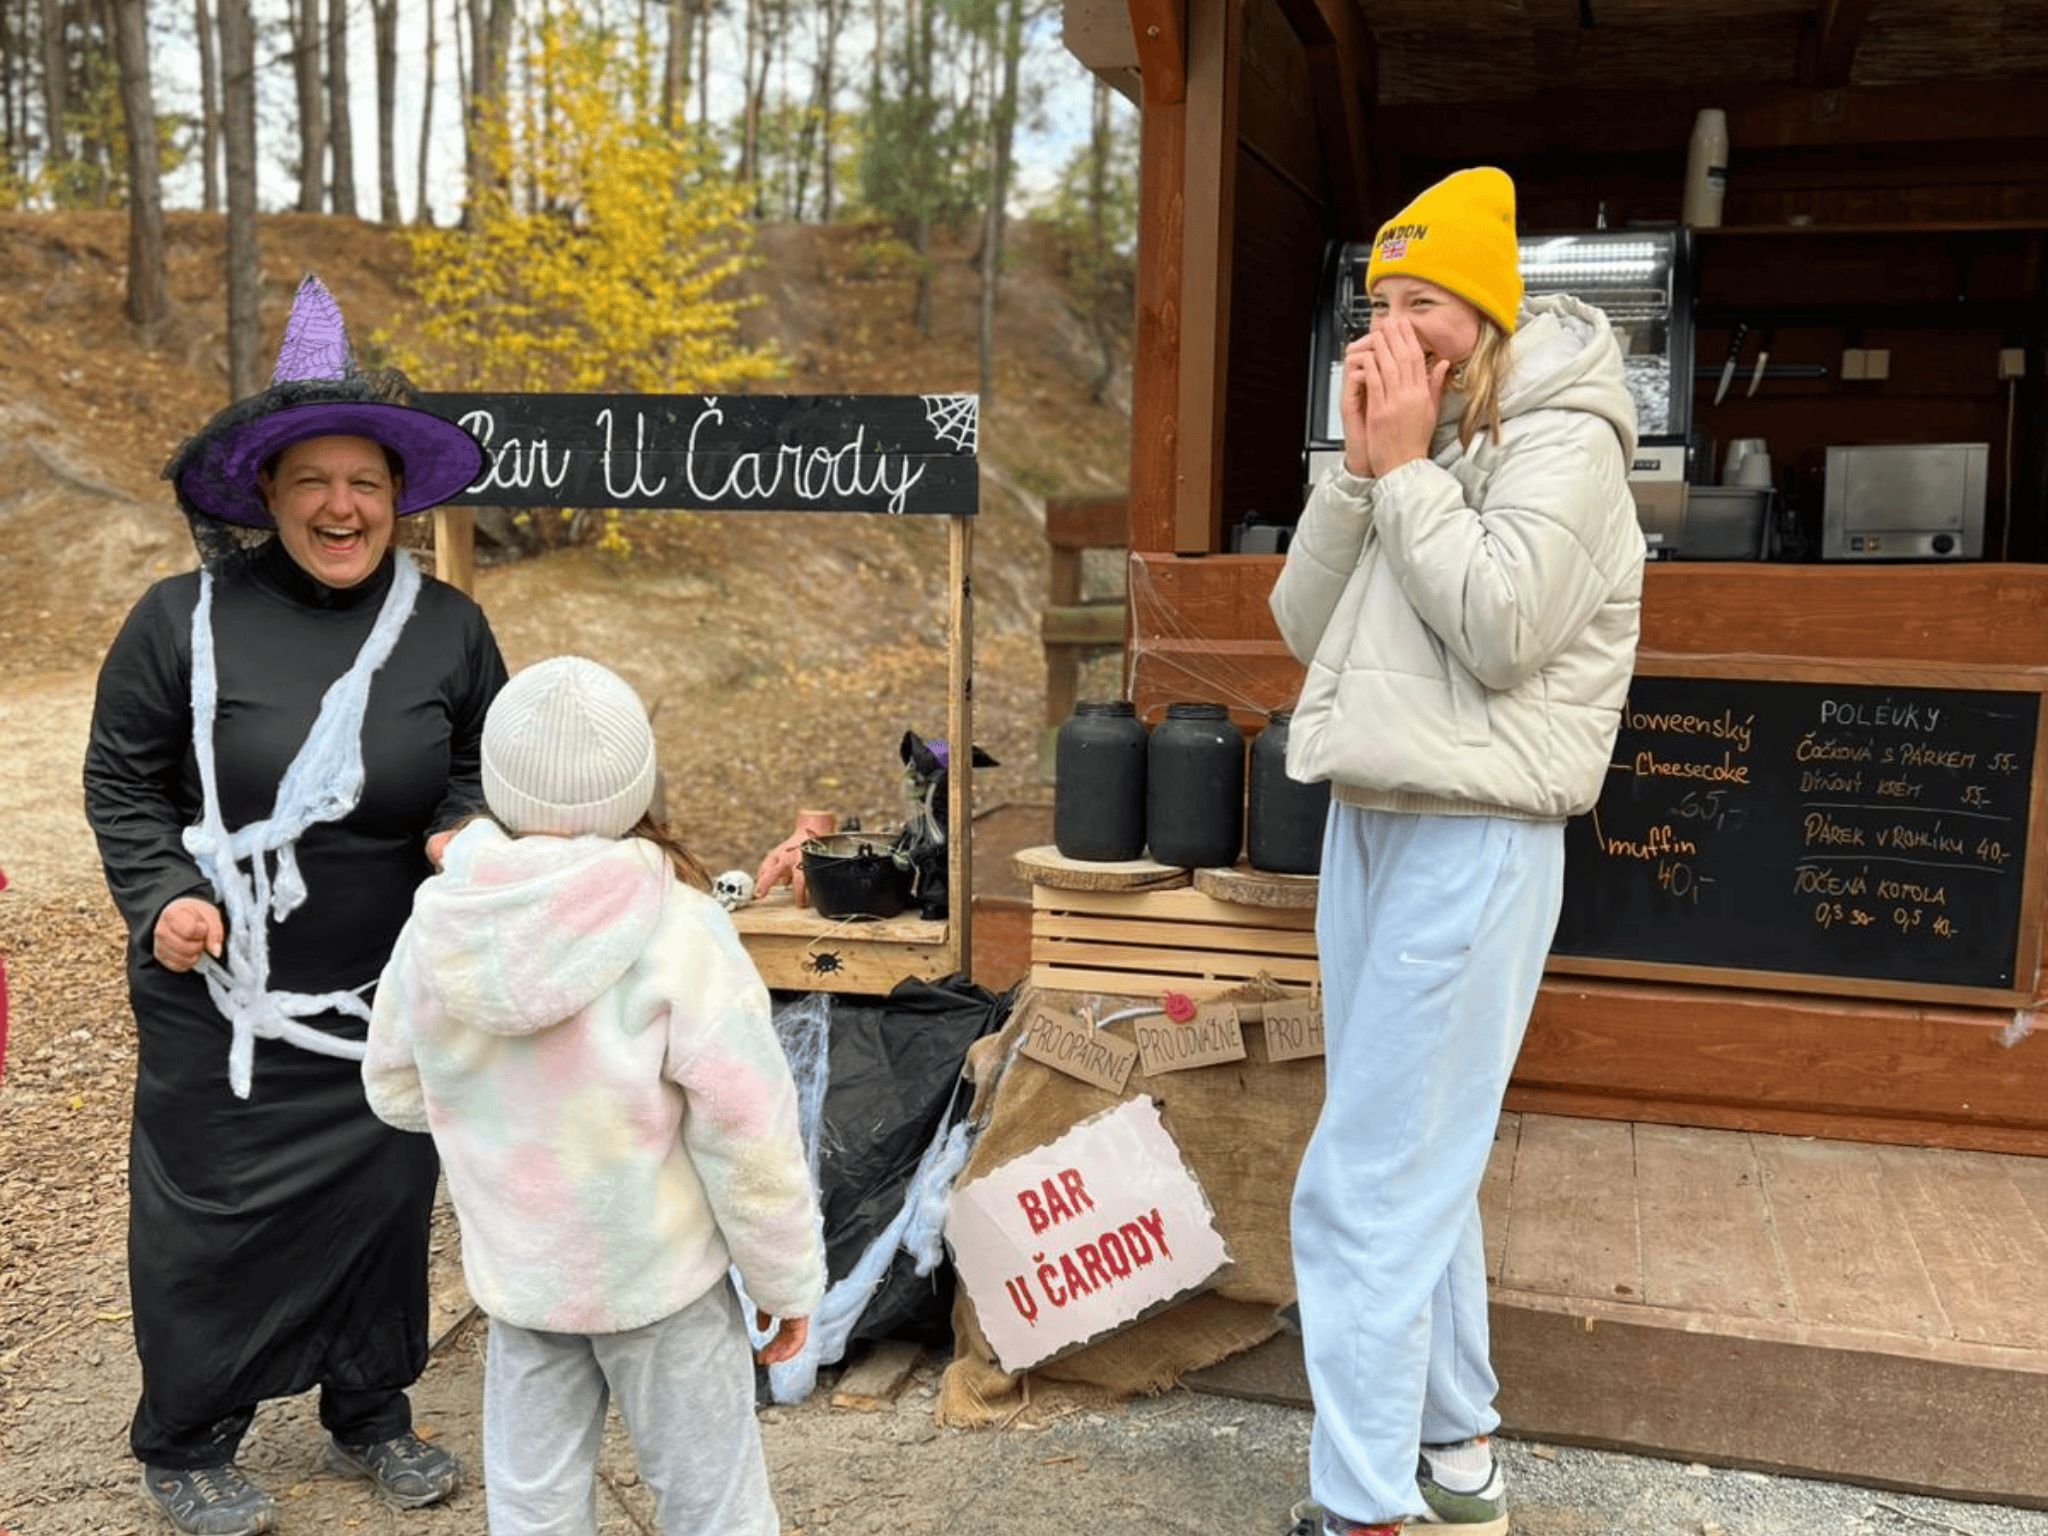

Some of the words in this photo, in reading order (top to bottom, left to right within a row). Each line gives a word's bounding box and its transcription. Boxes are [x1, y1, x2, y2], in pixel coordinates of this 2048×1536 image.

[596, 408, 667, 498] U
[686, 396, 926, 515] Čarody
[1619, 697, 1755, 752] loweenský
[1900, 742, 1976, 768] PÁRKEM
[1608, 825, 1698, 861] muffin
[1804, 812, 1866, 847] PÁREK
[1267, 1016, 1303, 1053] PRO
[1016, 1167, 1095, 1236] BAR
[1005, 1274, 1039, 1328] U
[1033, 1207, 1174, 1310] ČARODY
